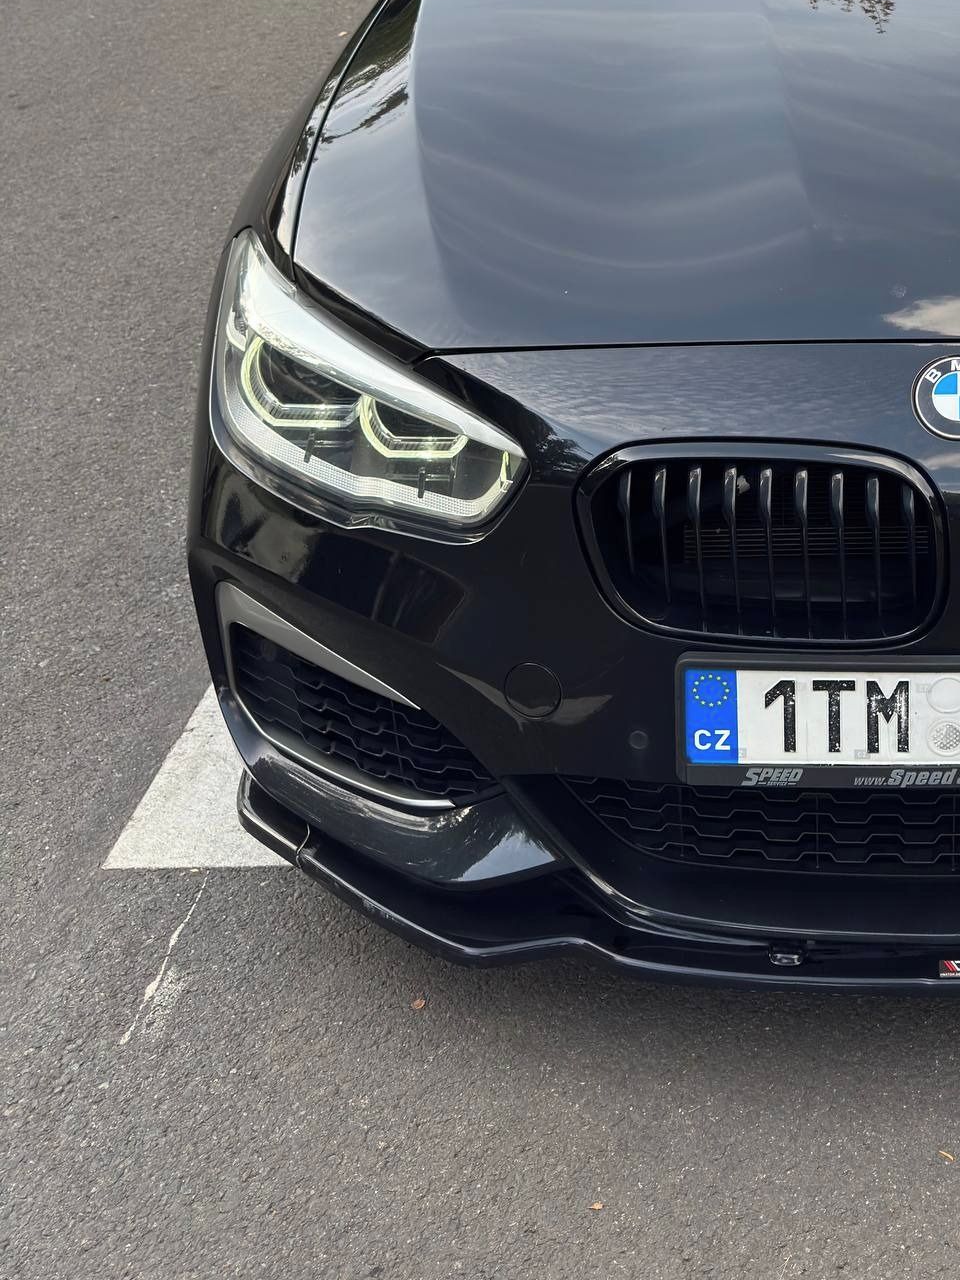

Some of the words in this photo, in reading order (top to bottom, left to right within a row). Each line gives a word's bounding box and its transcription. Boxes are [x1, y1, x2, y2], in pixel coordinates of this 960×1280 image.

[765, 680, 910, 753] 1TM
[694, 729, 731, 751] CZ
[741, 768, 803, 786] SPEED
